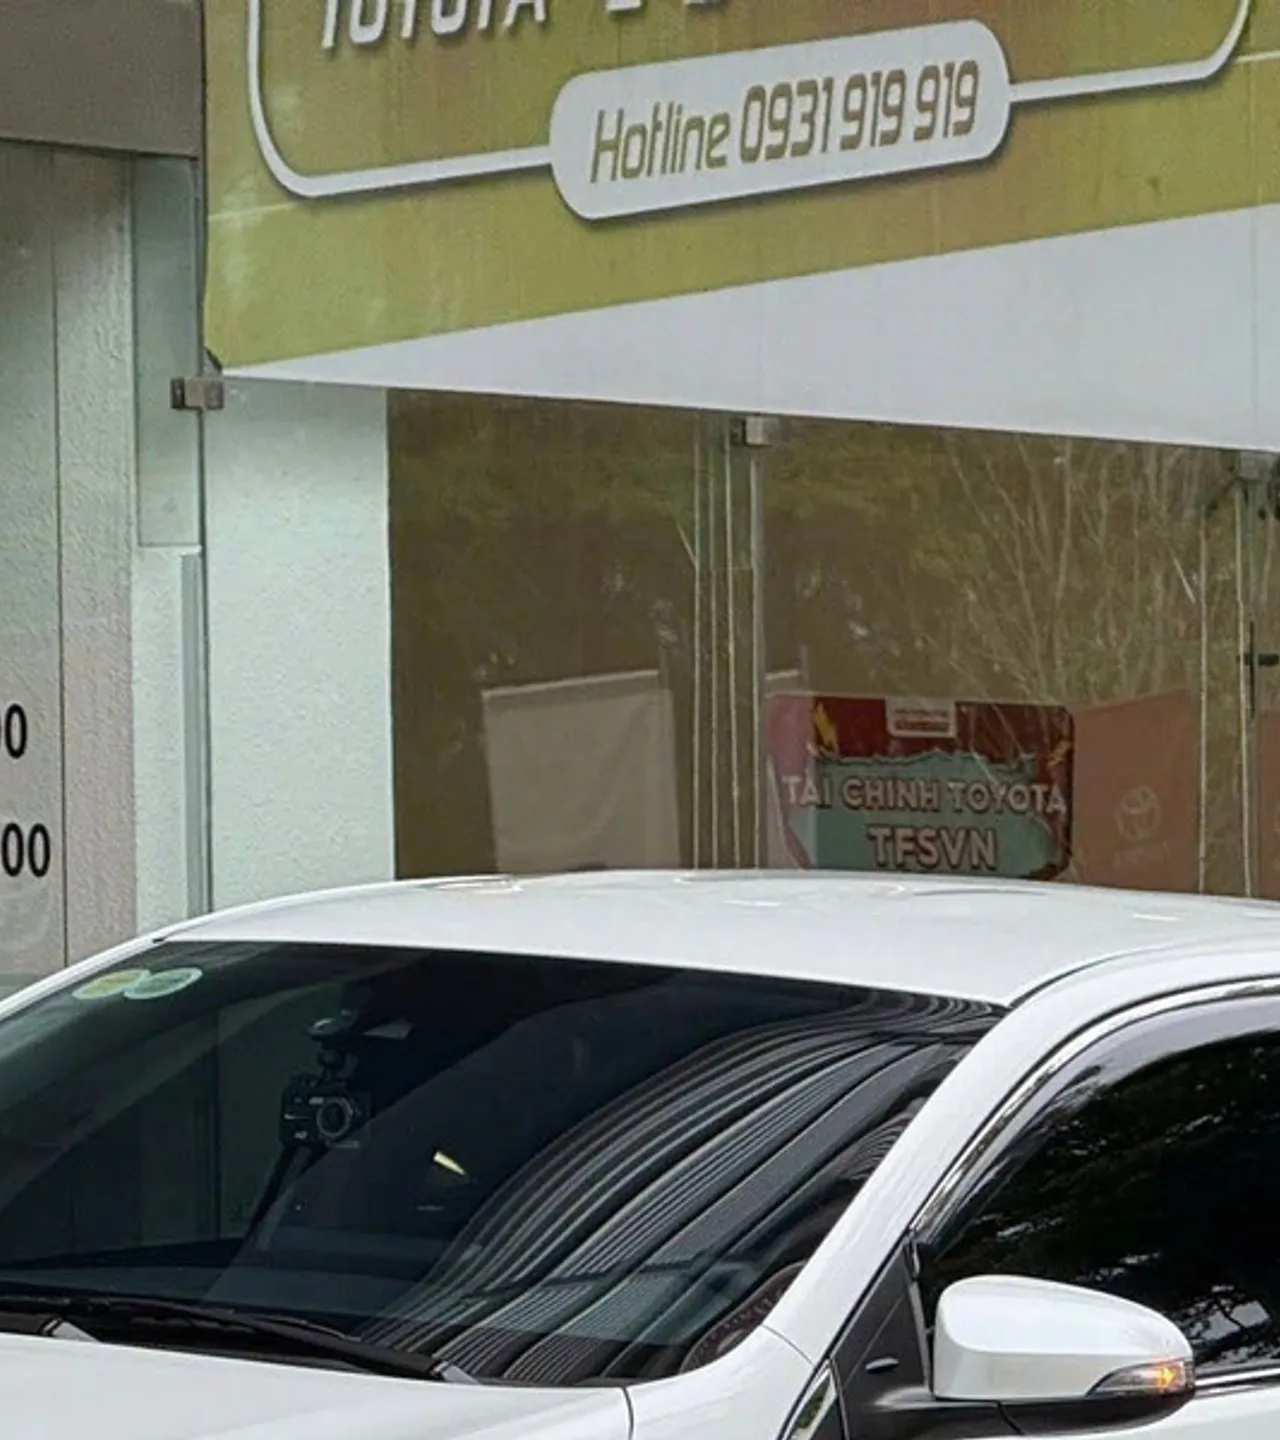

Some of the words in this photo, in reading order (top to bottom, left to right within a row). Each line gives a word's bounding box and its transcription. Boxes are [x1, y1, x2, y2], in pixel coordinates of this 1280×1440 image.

[590, 101, 731, 184] Hotline
[739, 76, 836, 164] 0931
[840, 68, 907, 152] 919
[913, 59, 980, 141] 919
[947, 781, 1067, 815] TOYOTA
[867, 823, 998, 870] TFSVN
